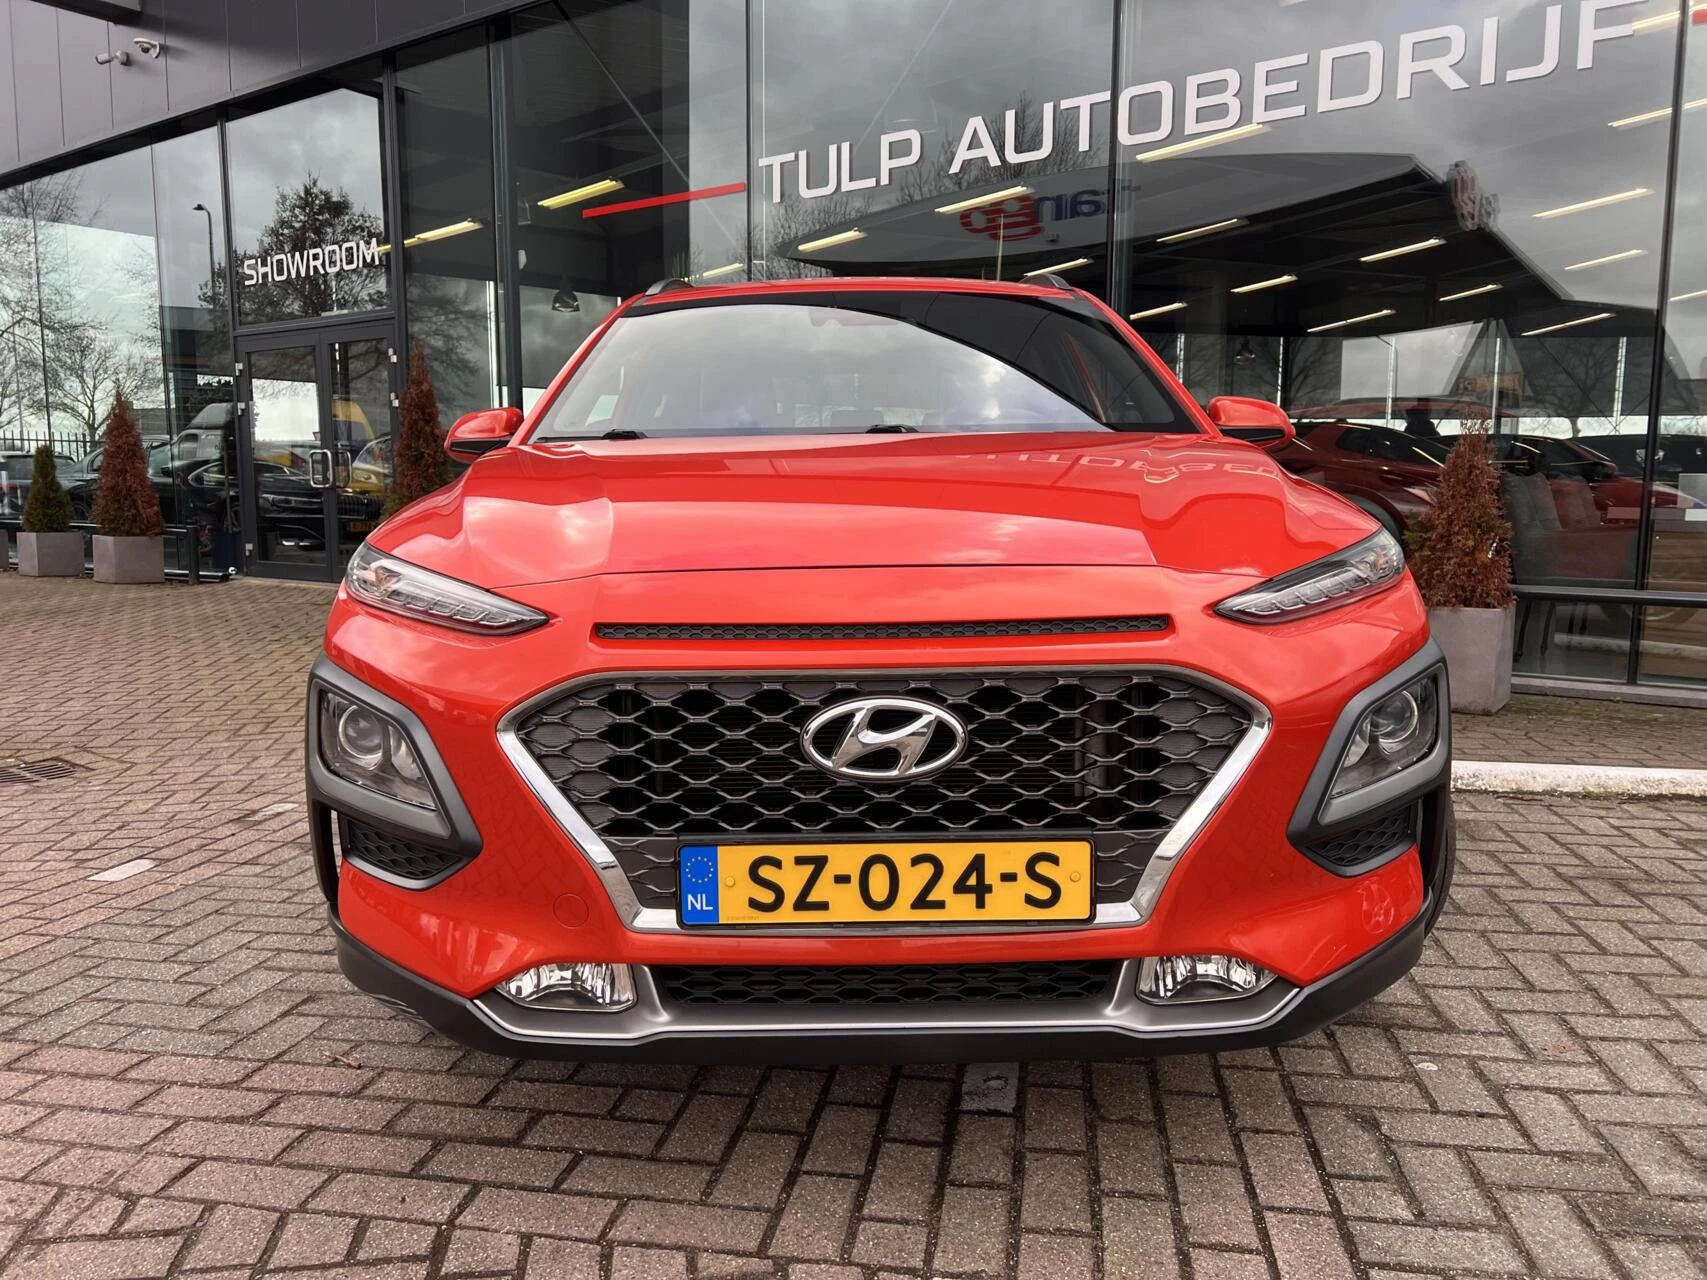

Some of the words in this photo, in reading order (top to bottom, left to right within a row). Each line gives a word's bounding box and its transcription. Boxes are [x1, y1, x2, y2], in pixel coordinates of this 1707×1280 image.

[758, 128, 921, 204] TULP
[949, 0, 1648, 174] AUTOBEDRIJF
[243, 237, 380, 286] SHOWROOM
[687, 893, 714, 911] NL
[747, 851, 1063, 913] SZ-024-S
